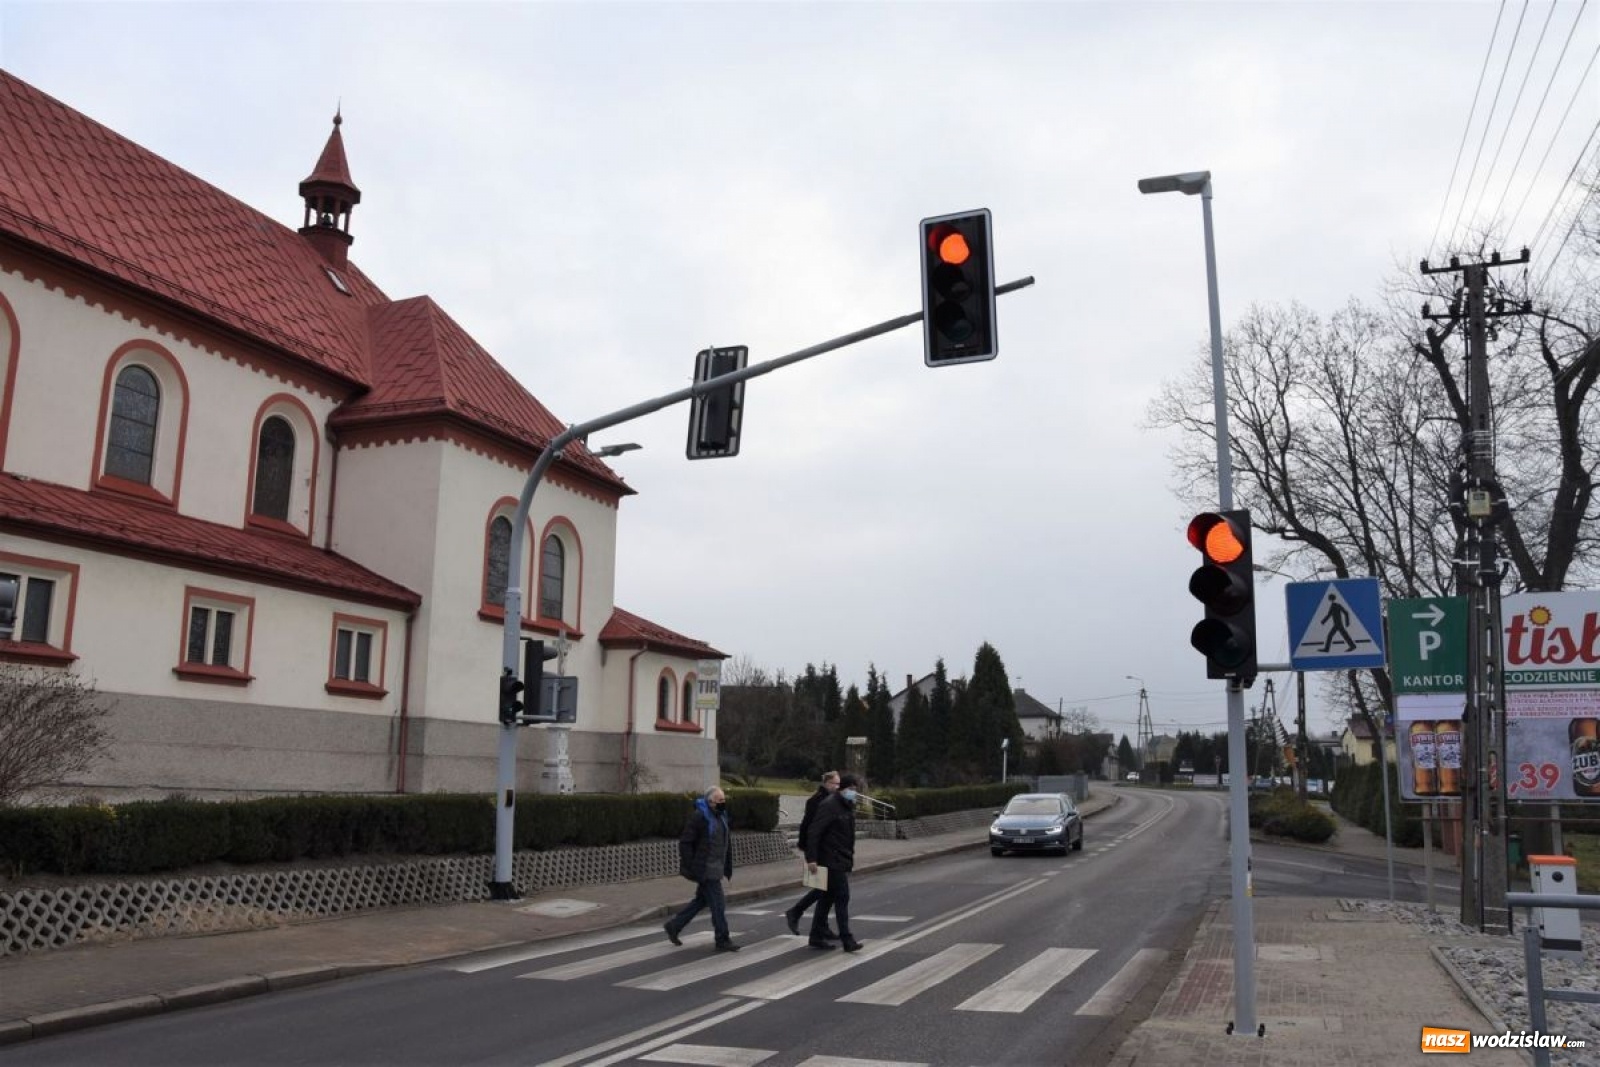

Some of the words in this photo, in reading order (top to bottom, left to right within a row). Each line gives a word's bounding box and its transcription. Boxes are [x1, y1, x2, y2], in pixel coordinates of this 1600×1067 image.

[1419, 630, 1442, 661] P
[697, 680, 719, 694] TIR
[1403, 675, 1464, 687] KANTOR
